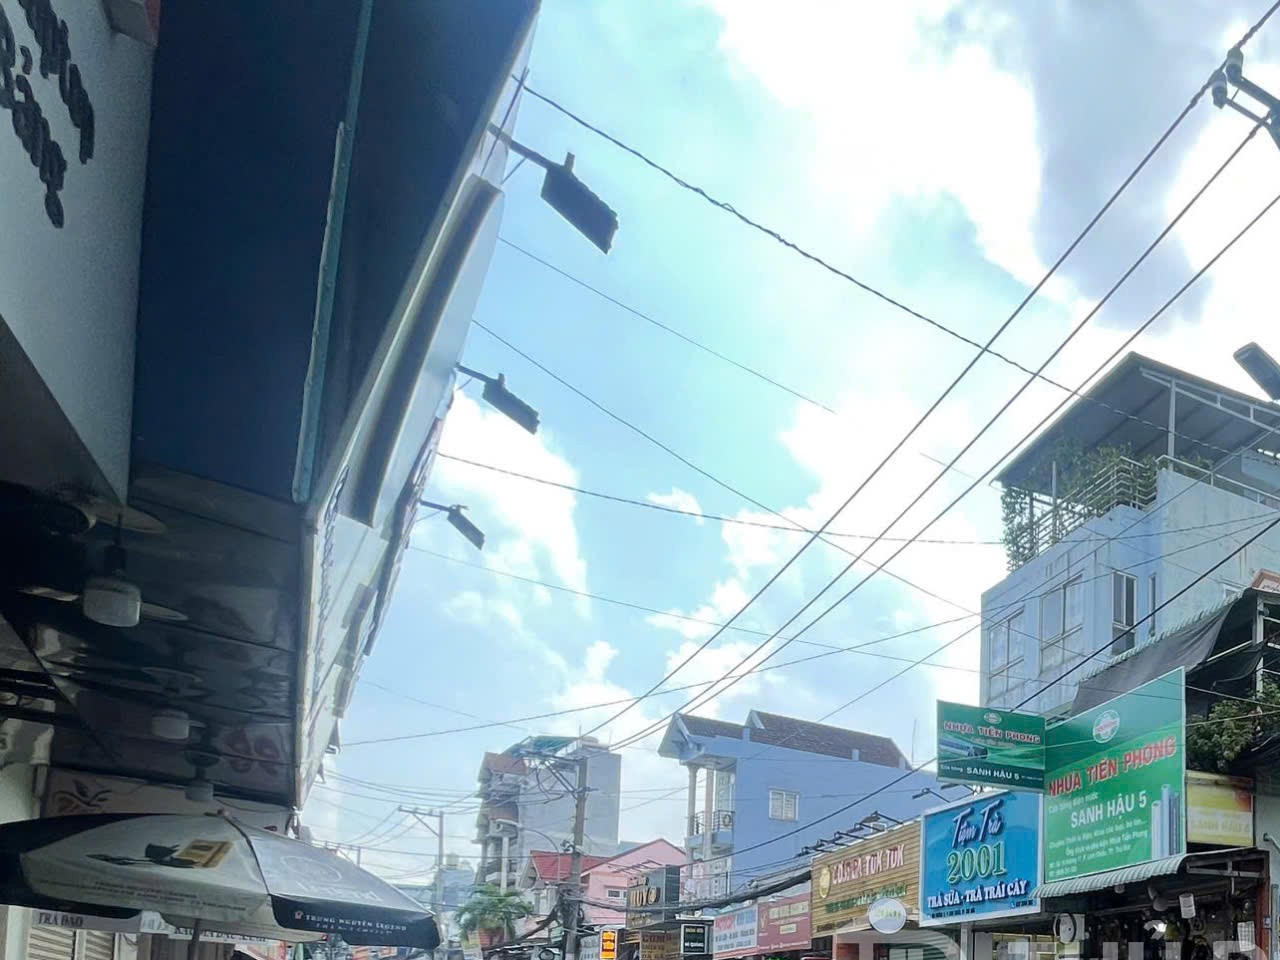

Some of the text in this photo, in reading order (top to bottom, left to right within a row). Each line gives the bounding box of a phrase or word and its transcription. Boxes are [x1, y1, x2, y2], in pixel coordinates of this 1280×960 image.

[1005, 730, 1040, 744] PHONG
[1124, 736, 1176, 773] PHONG
[966, 767, 992, 777] SANH
[993, 770, 1012, 780] HẬU
[1071, 790, 1147, 828] SANH HẬU 5
[947, 841, 1007, 884] 2001
[984, 881, 1005, 901] TRÁI
[1006, 878, 1028, 895] CÂY
[306, 914, 336, 923] TRUNG
